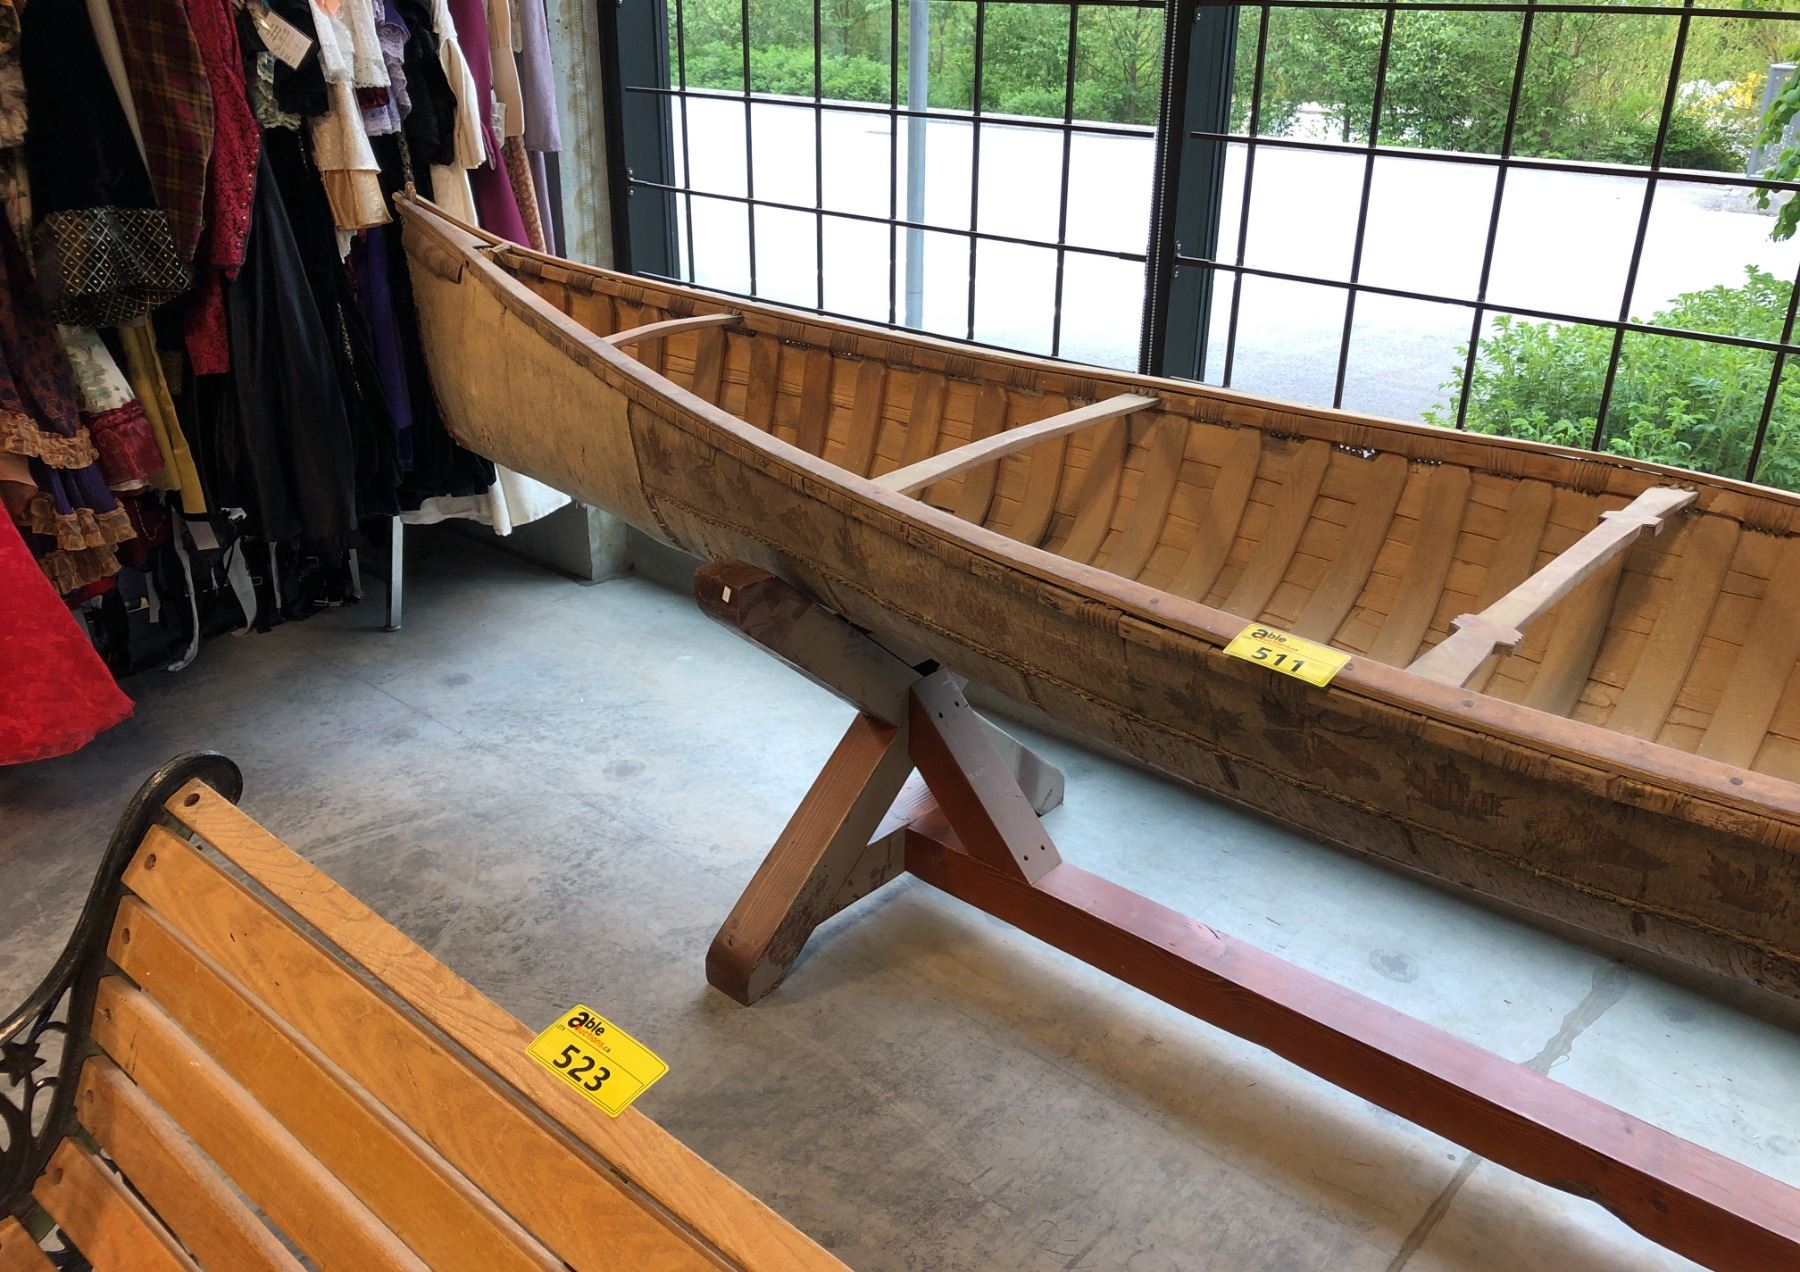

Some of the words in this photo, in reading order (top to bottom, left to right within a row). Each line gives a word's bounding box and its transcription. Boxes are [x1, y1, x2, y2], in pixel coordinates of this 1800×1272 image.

[1251, 628, 1287, 643] able
[1251, 647, 1305, 672] 511
[567, 1011, 605, 1036] able
[552, 1044, 611, 1091] 523
